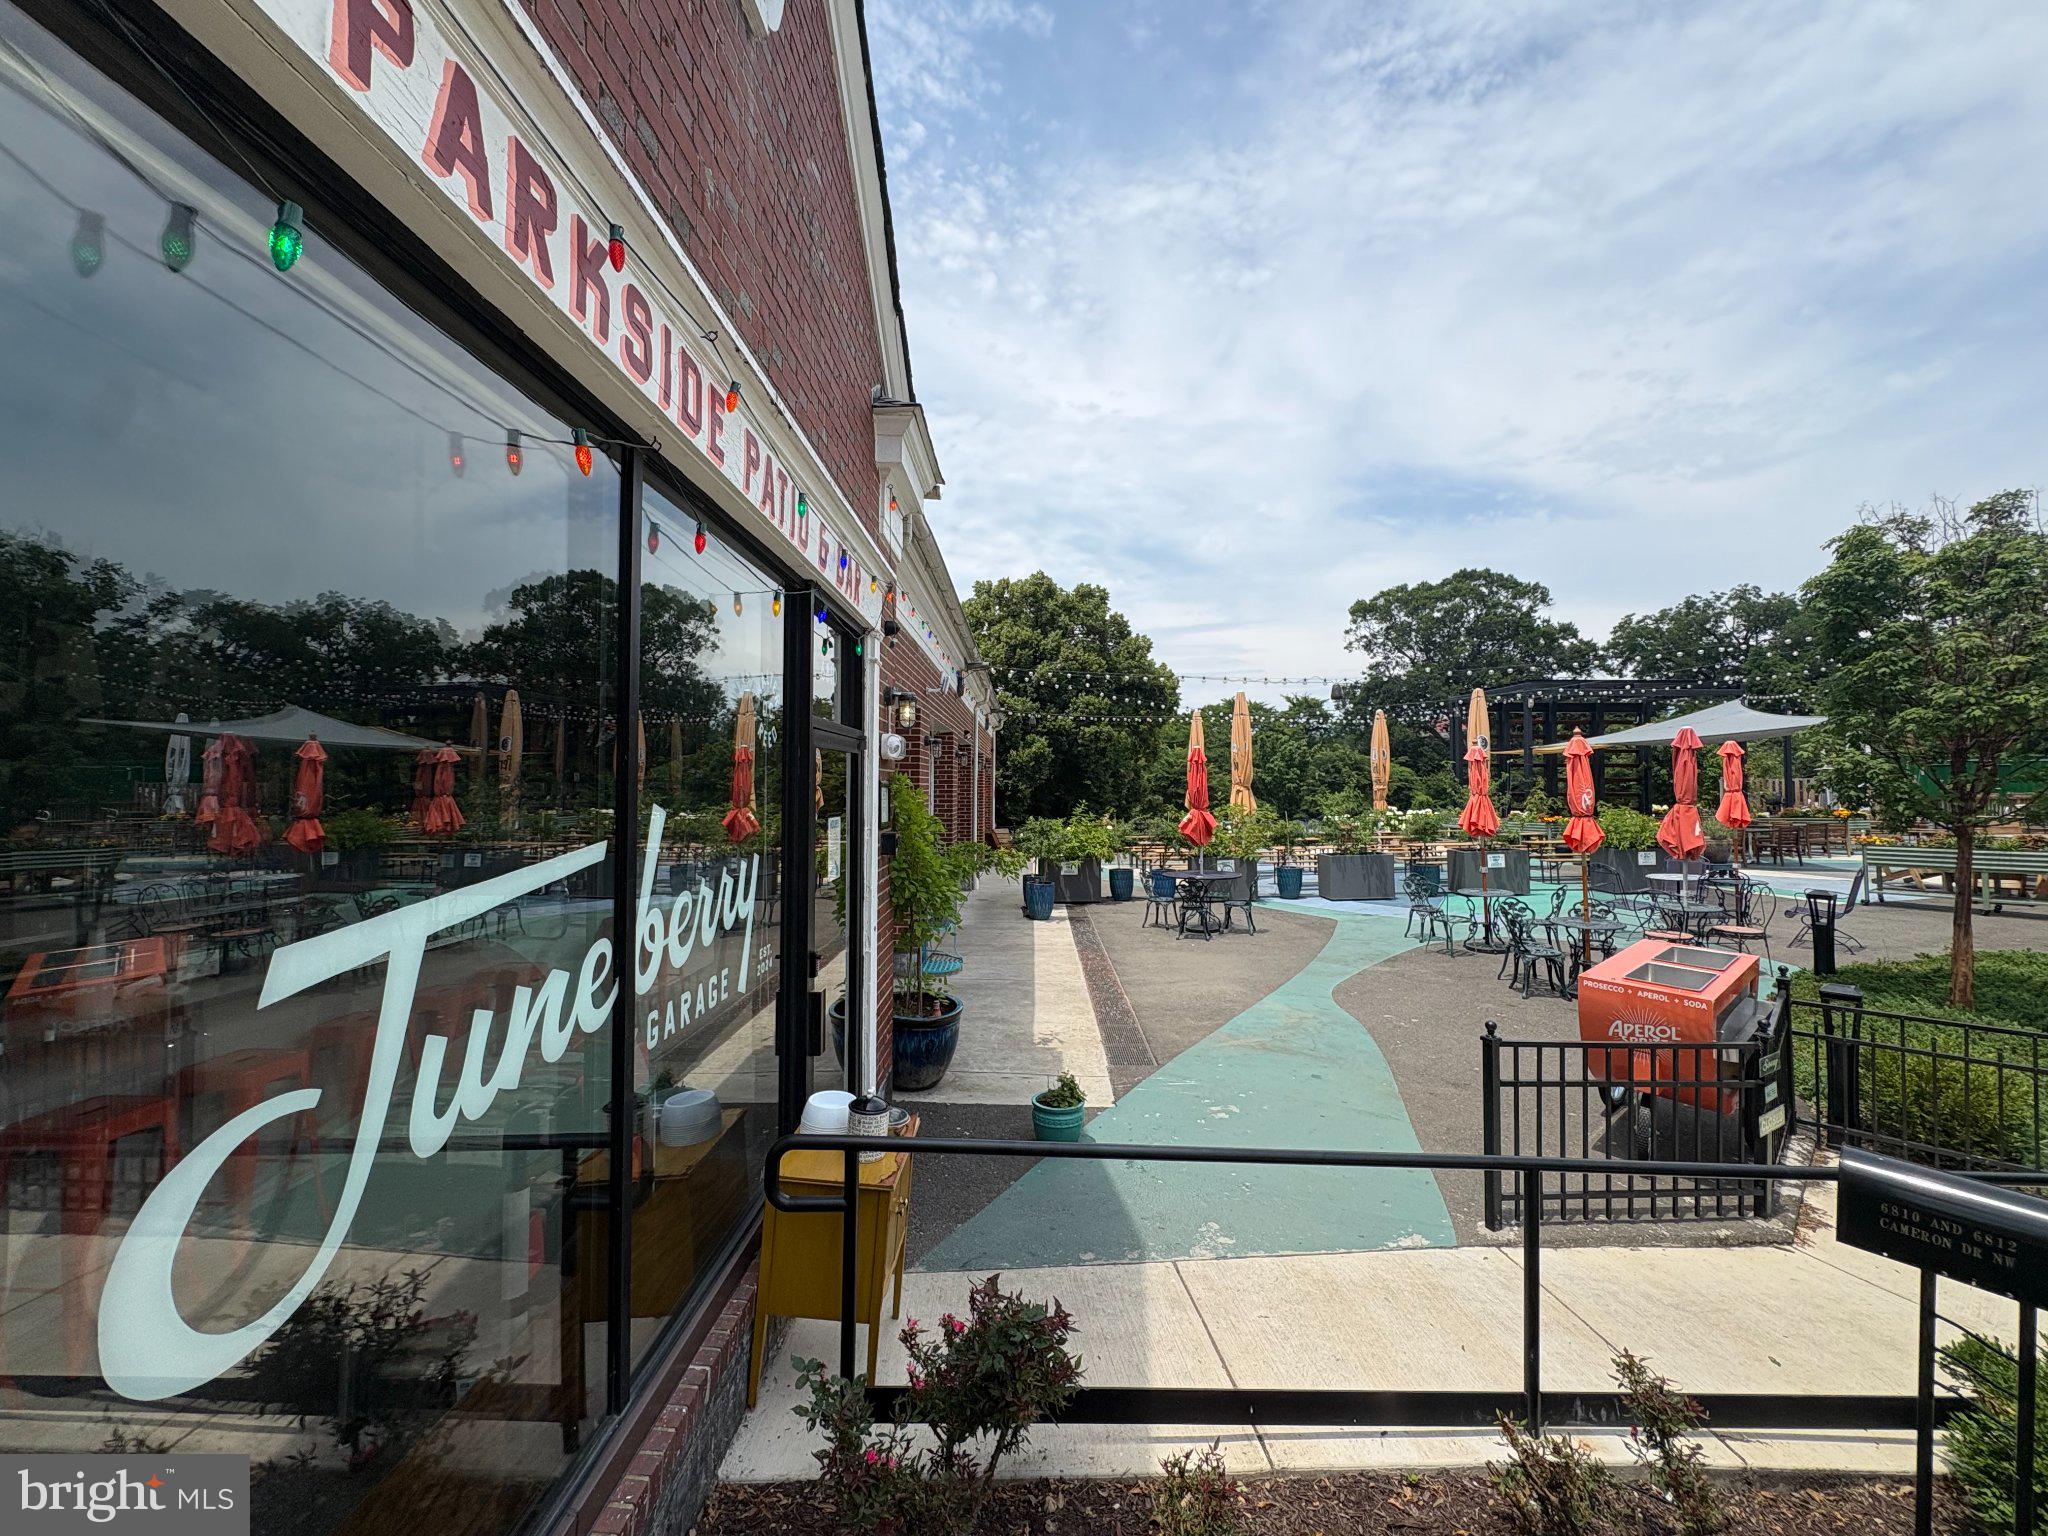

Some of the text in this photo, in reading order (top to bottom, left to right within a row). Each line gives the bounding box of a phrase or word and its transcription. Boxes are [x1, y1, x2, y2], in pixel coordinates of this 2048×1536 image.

[329, 0, 727, 469] PARKSIDE
[742, 427, 810, 554] PATIO
[836, 541, 862, 607] BAR
[759, 943, 773, 960] EST.
[646, 967, 729, 1051] GARAGE
[1583, 980, 1625, 994] PROSECCO
[1637, 990, 1670, 1003] APEROL
[1683, 999, 1708, 1011] SODA
[1608, 1020, 1681, 1041] APEROL
[1879, 1217, 2017, 1269] CAMERON DR NW
[1880, 1202, 2018, 1253] 6810 AND 6812
